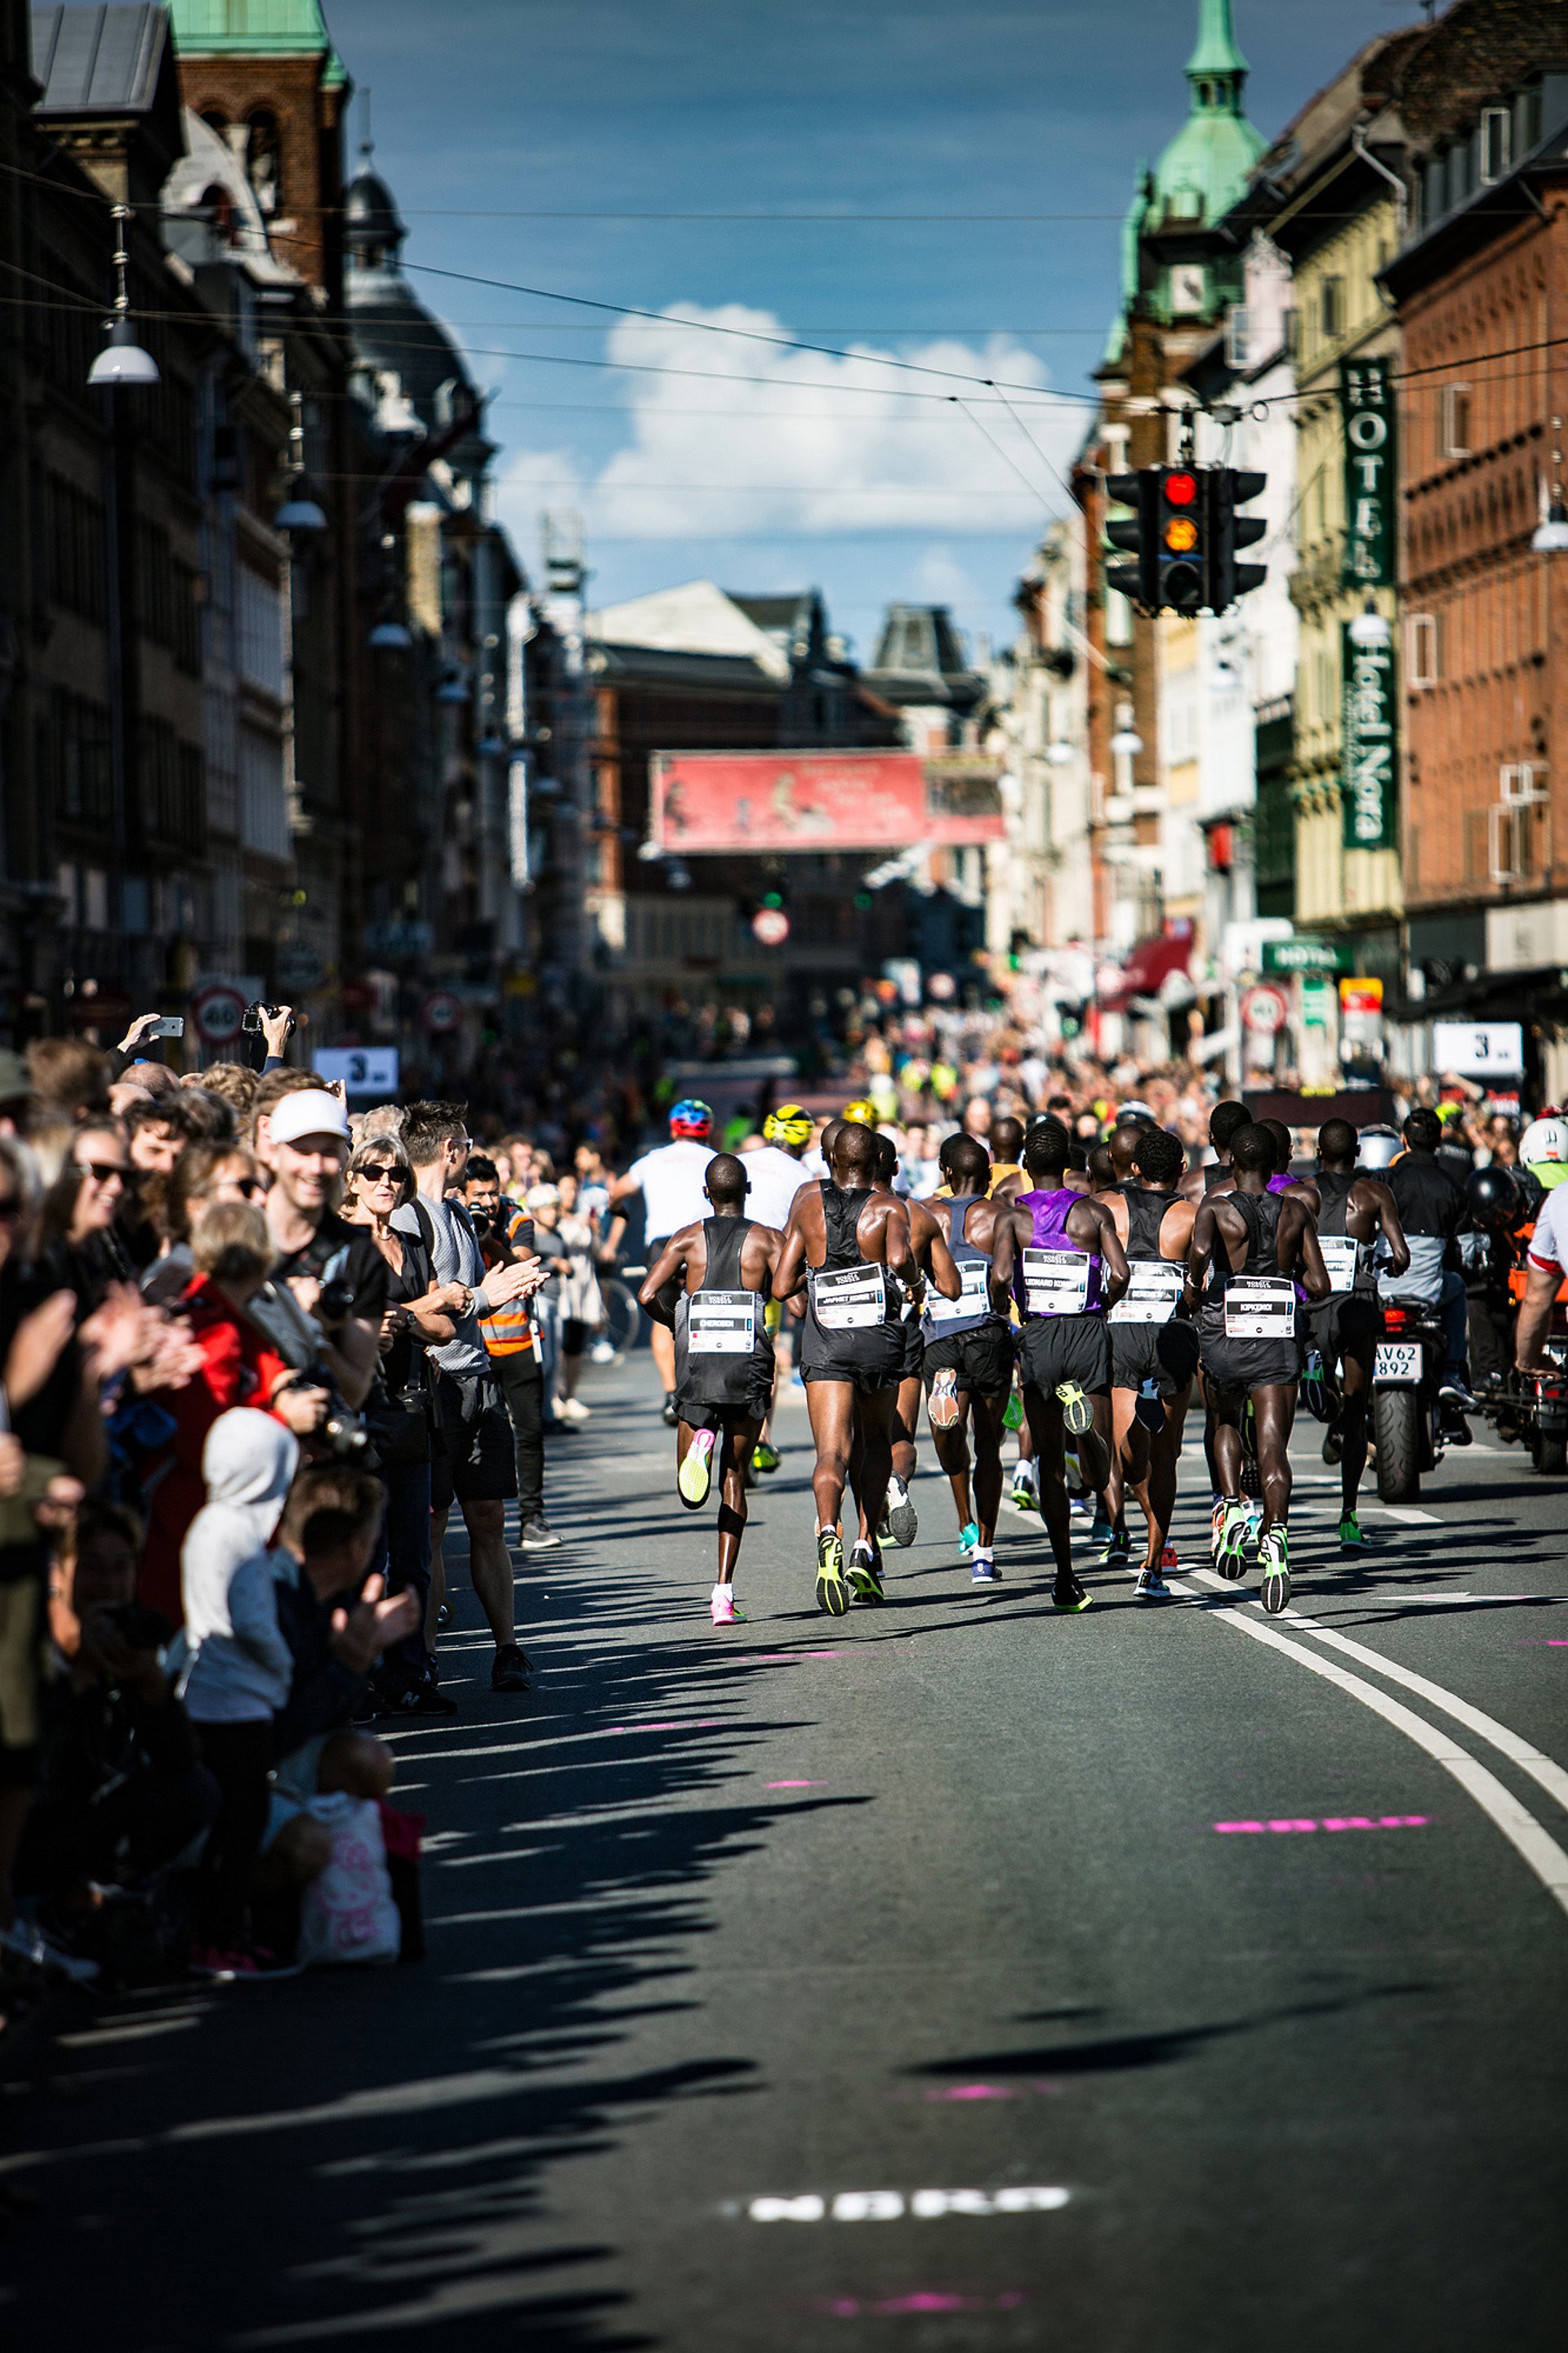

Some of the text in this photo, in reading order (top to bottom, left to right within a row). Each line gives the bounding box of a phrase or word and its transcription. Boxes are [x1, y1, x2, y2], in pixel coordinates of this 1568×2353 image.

[1348, 368, 1388, 579] HOTEL
[1475, 1033, 1489, 1058] 3
[349, 1054, 368, 1083] 3
[1379, 1361, 1410, 1375] 892
